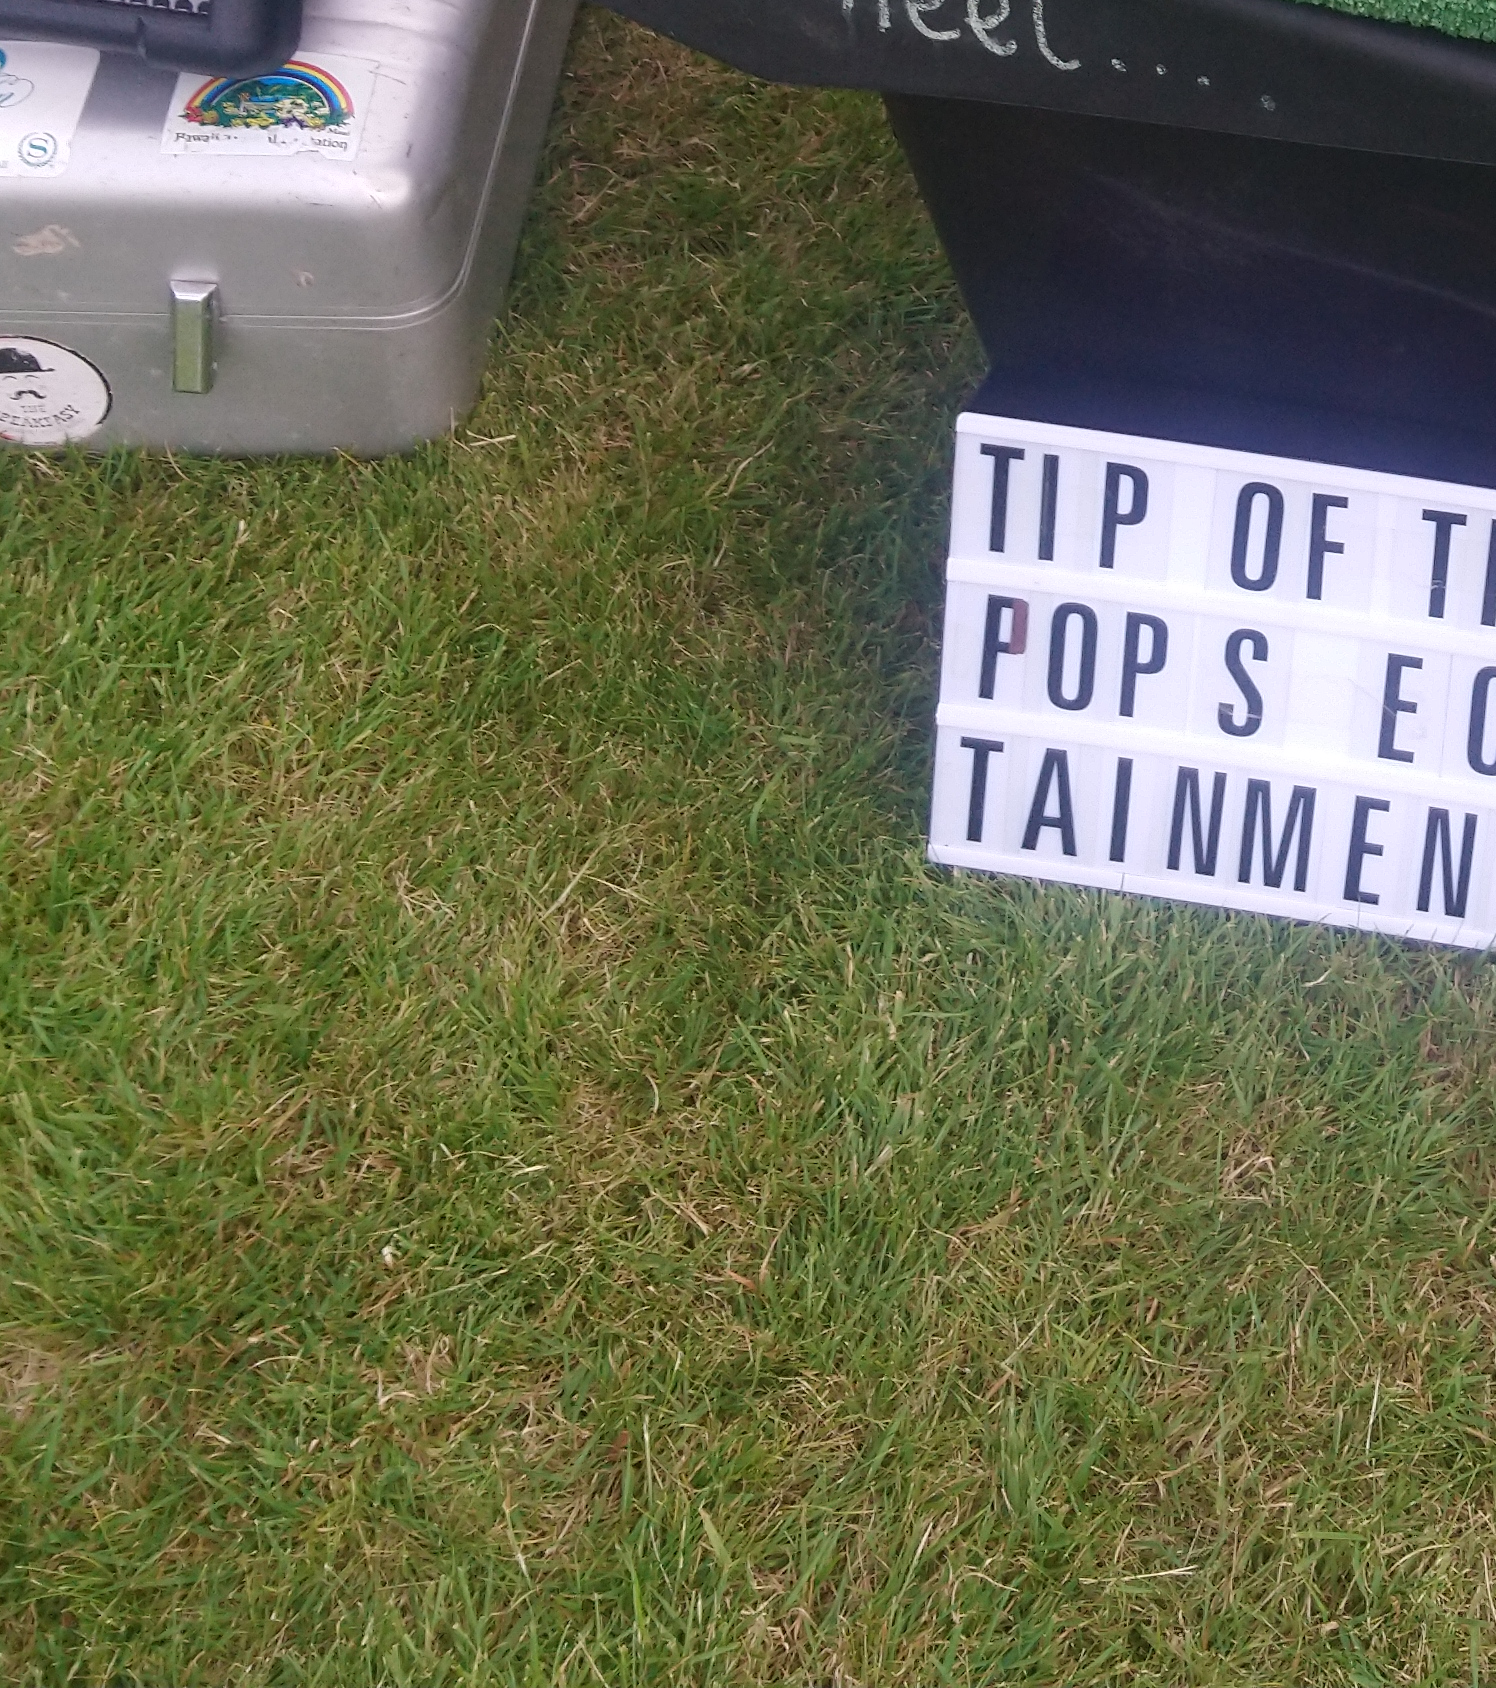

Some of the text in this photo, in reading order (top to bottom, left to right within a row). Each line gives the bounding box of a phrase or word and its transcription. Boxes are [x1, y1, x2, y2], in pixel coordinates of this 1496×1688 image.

[980, 443, 1149, 569] TIP
[1230, 481, 1349, 601] OF
[978, 593, 1269, 737] POPS
